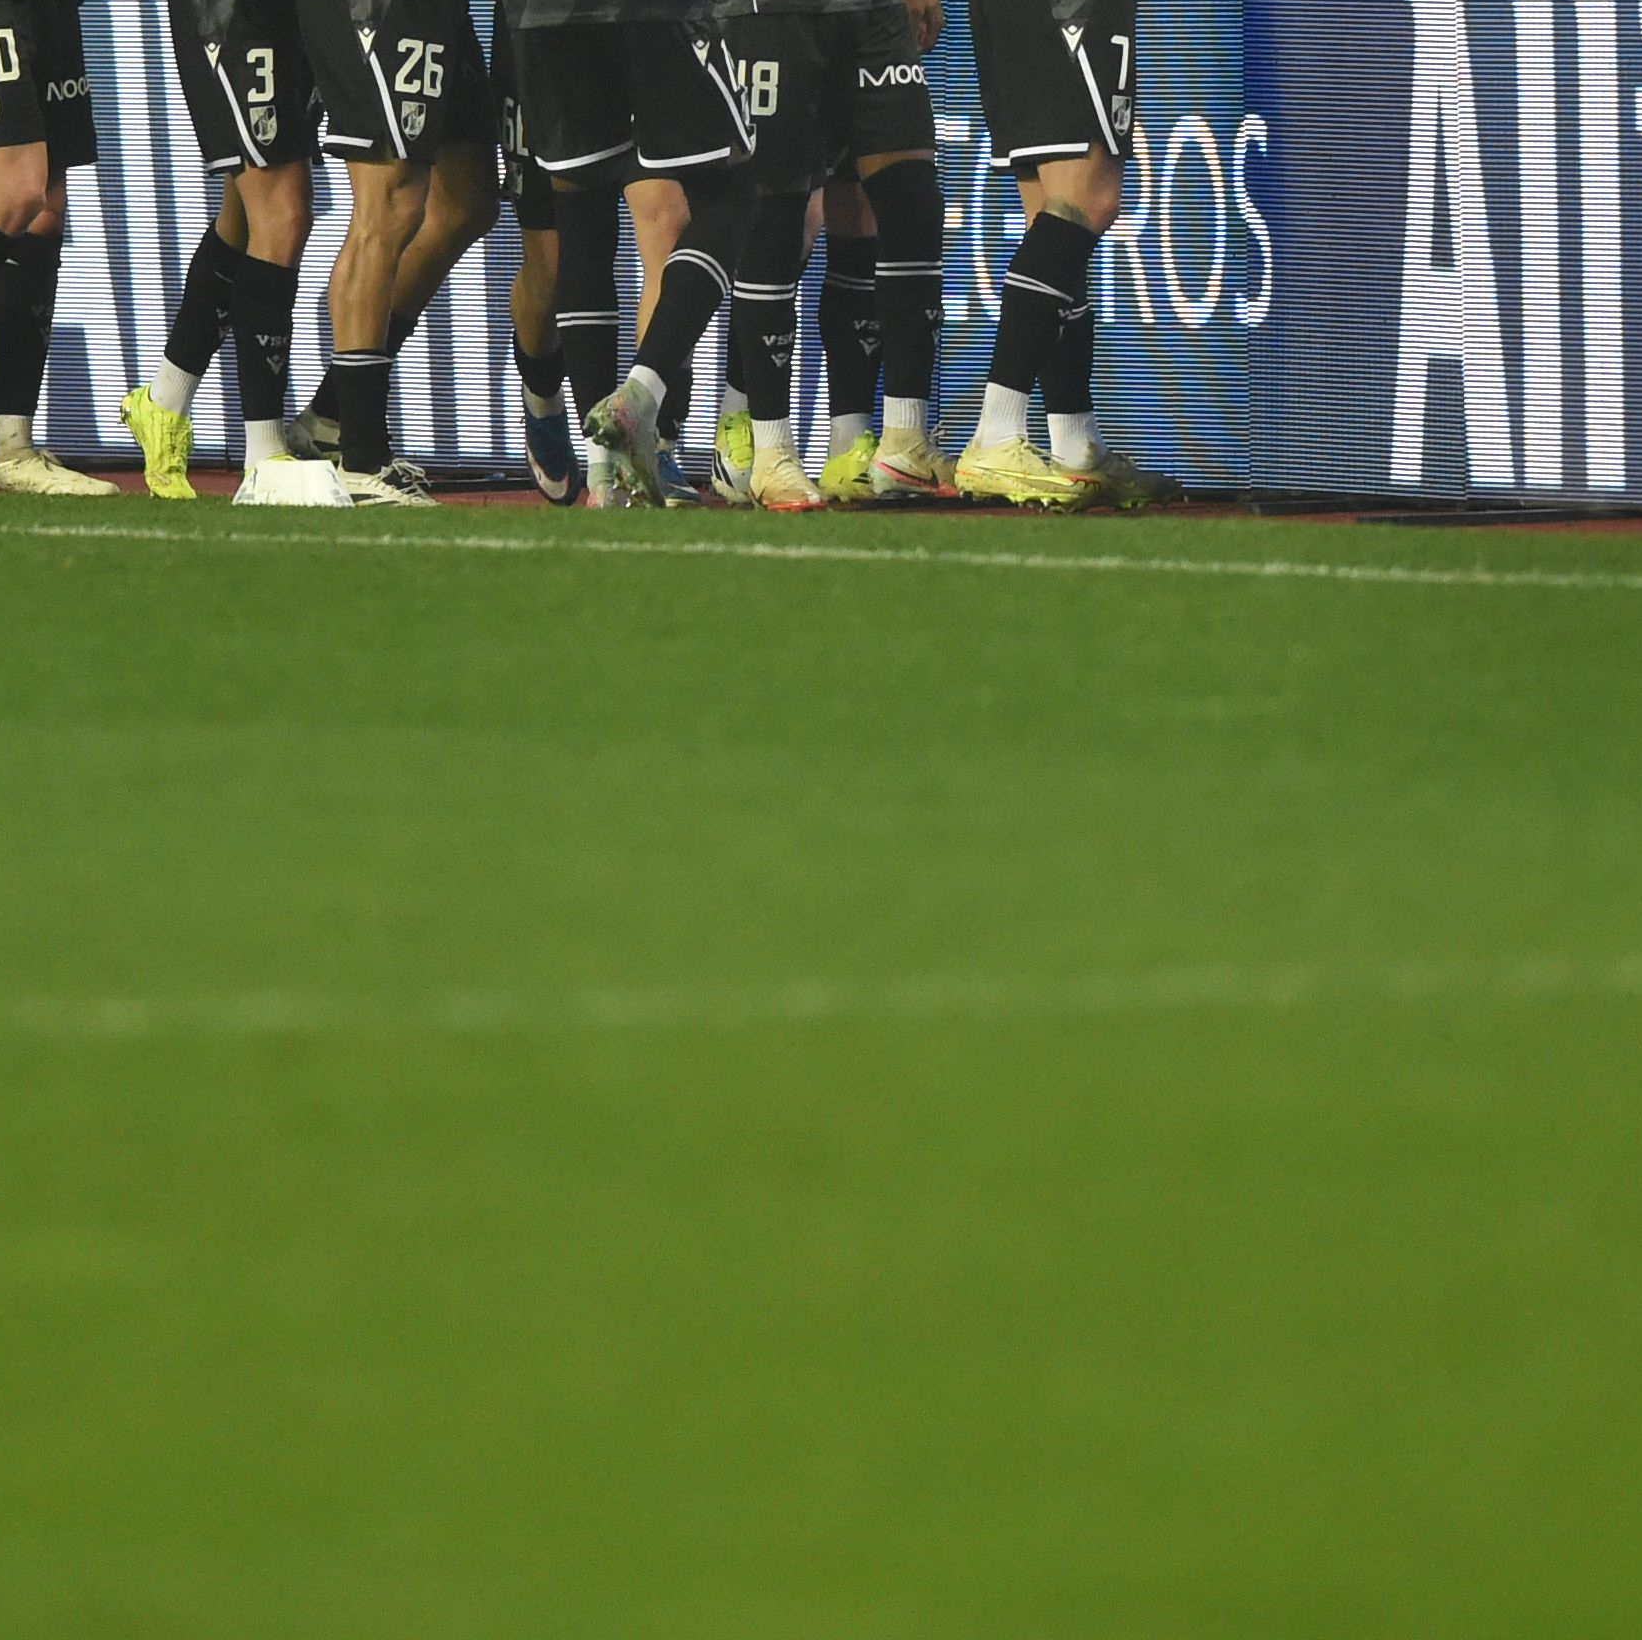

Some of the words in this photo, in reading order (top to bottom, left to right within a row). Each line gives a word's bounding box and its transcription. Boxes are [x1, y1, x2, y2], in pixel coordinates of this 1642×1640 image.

[246, 47, 275, 103] 3
[394, 37, 445, 98] 26
[1111, 35, 1129, 90] 7
